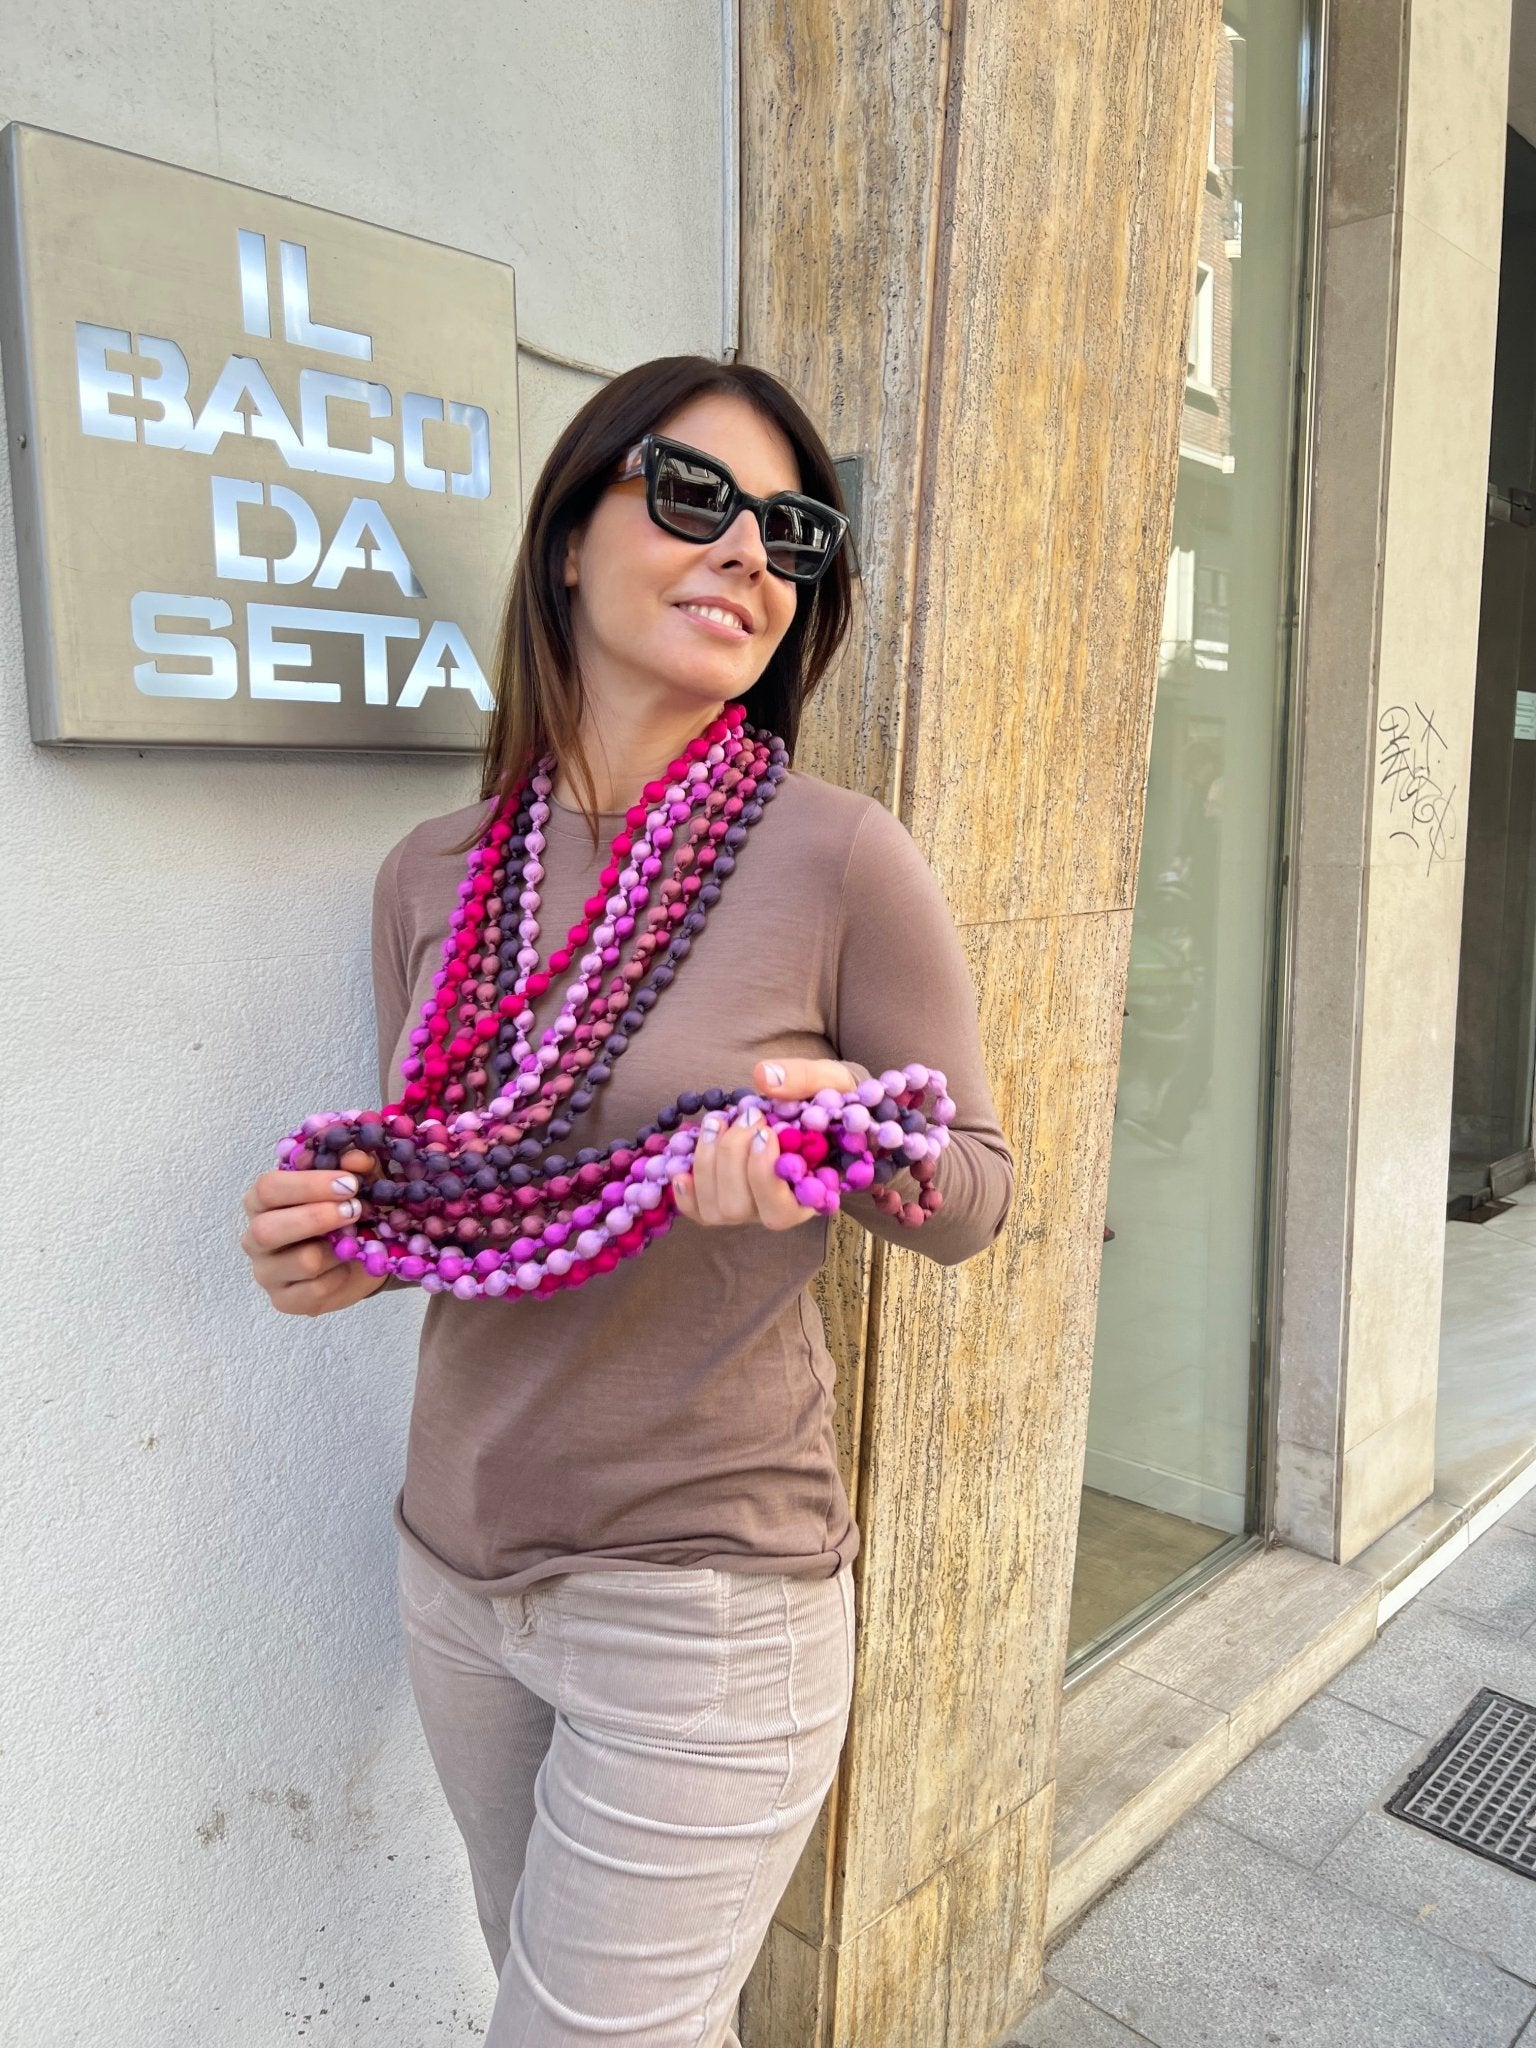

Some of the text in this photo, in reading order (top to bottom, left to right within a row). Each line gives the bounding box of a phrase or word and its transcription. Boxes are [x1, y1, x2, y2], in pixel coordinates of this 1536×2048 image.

[237, 228, 373, 361] IL
[75, 320, 491, 500] BACO
[211, 475, 427, 598] DA
[131, 591, 497, 711] SETA
